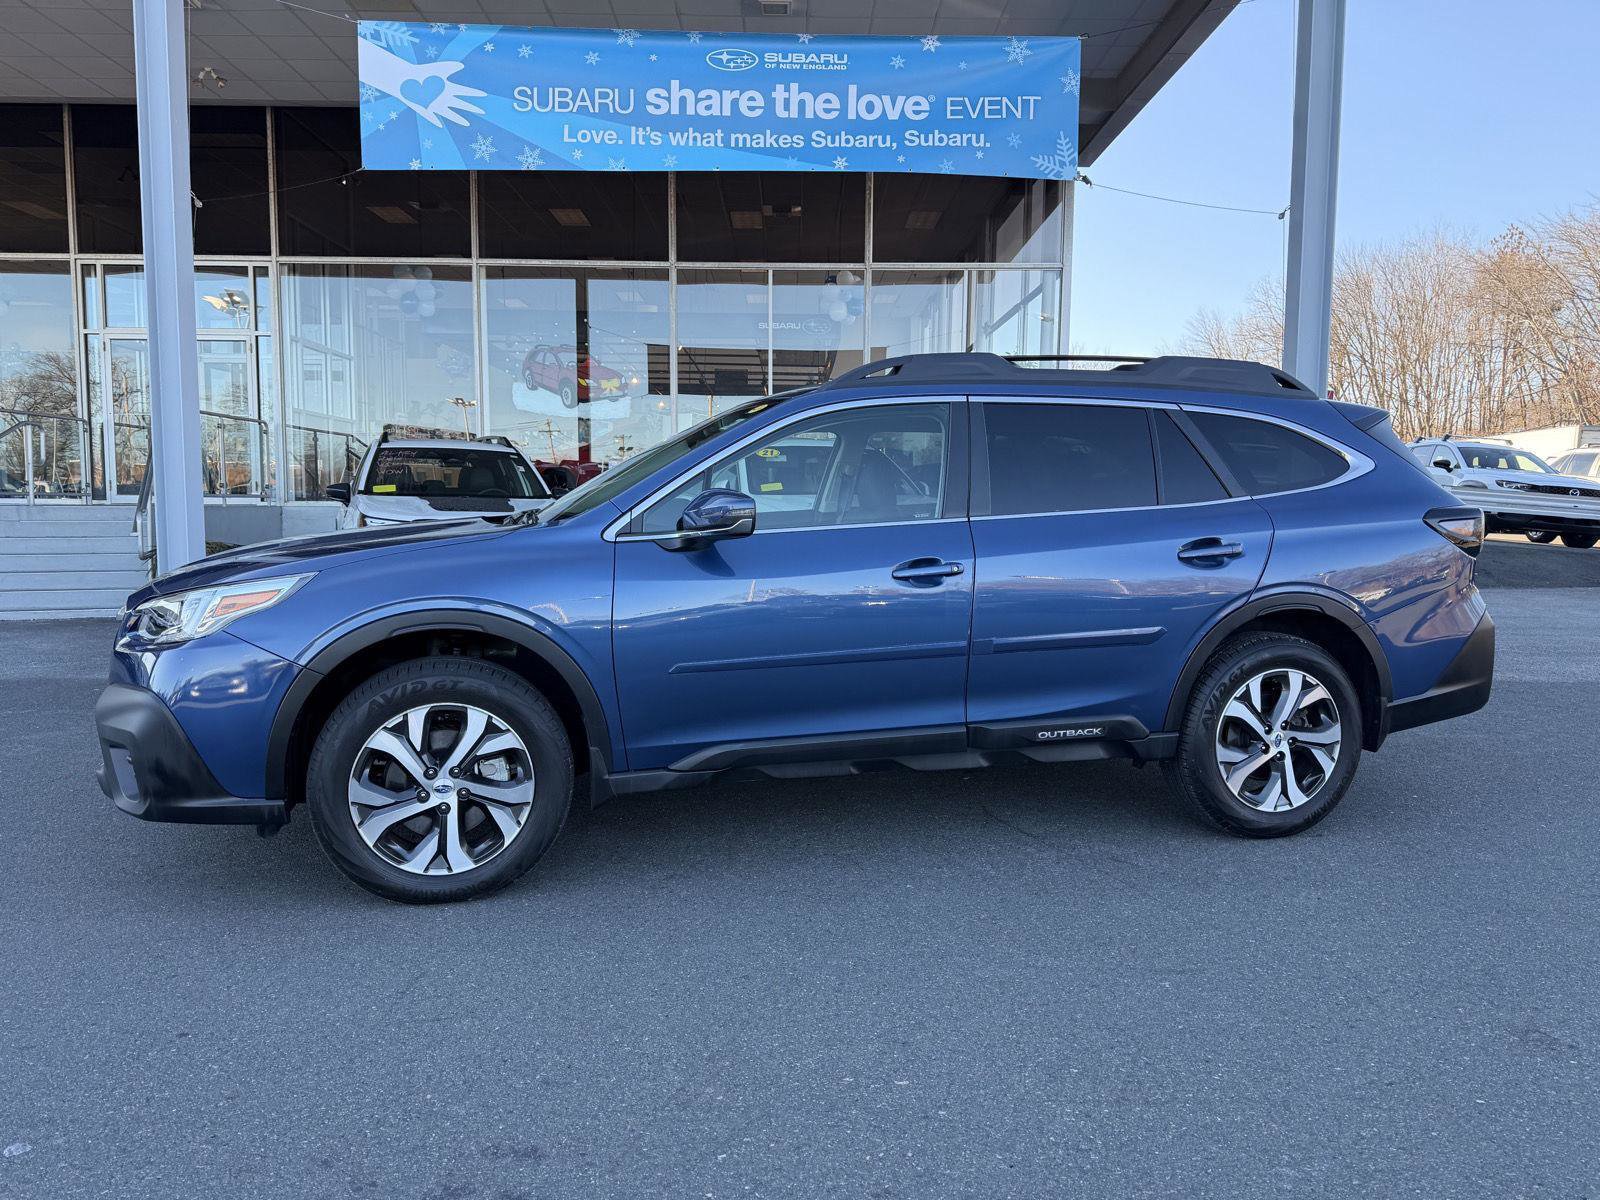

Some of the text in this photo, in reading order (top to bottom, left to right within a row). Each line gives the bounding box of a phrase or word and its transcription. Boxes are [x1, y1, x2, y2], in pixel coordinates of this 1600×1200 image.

[764, 52, 848, 64] SUBARU
[512, 86, 635, 114] SUBARU
[645, 79, 765, 118] share
[771, 82, 841, 120] the
[946, 95, 1042, 120] EVENT
[563, 124, 991, 150] Love. It’s what makes Subaru, Subaru.
[1038, 727, 1103, 739] OUTBACK
